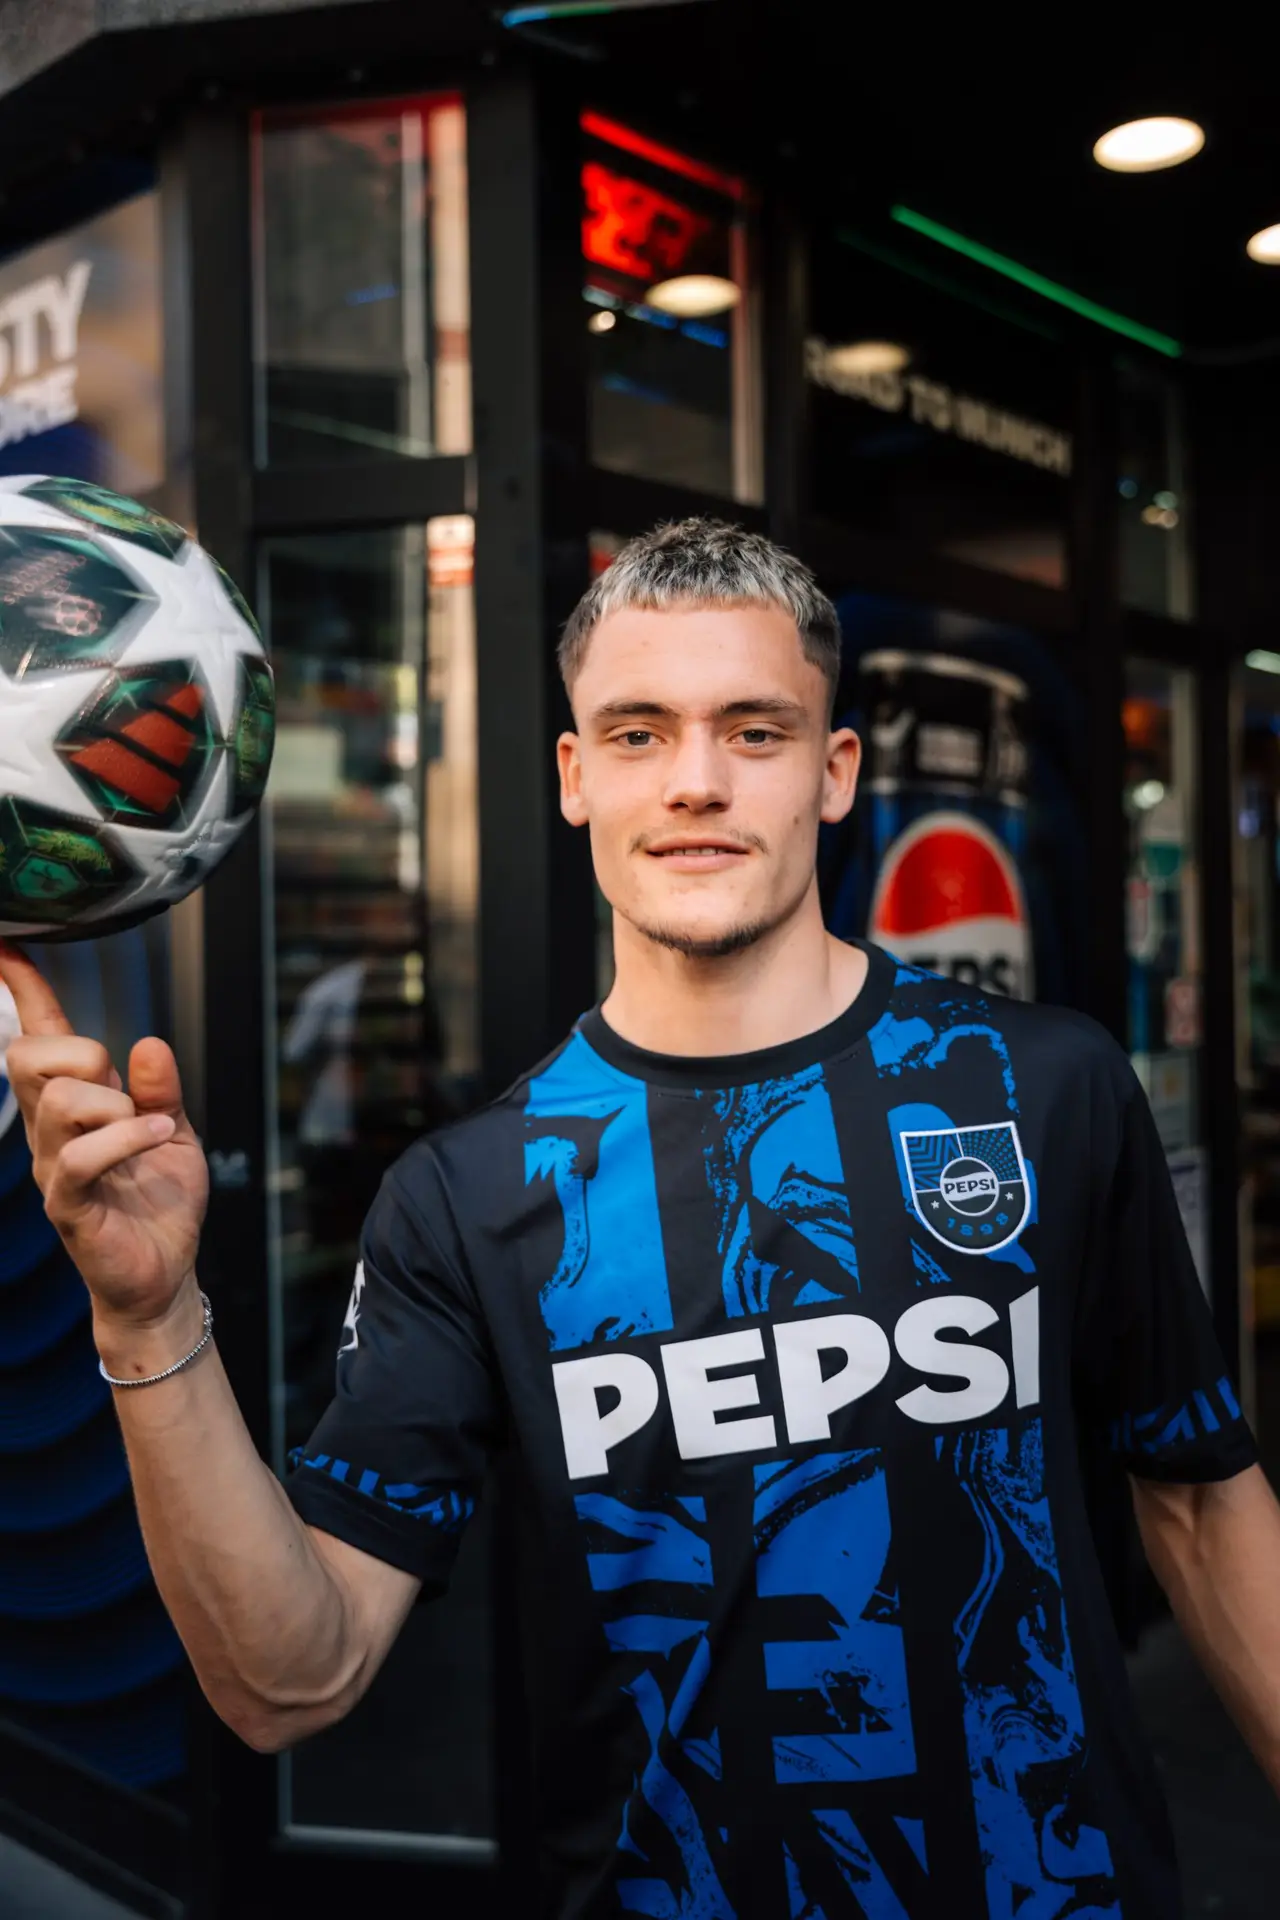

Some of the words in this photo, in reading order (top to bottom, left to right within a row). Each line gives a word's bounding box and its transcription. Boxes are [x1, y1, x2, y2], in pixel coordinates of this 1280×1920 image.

[0, 258, 93, 388] TY
[943, 1177, 996, 1195] PEPSI
[551, 1285, 1040, 1480] PEPSI
